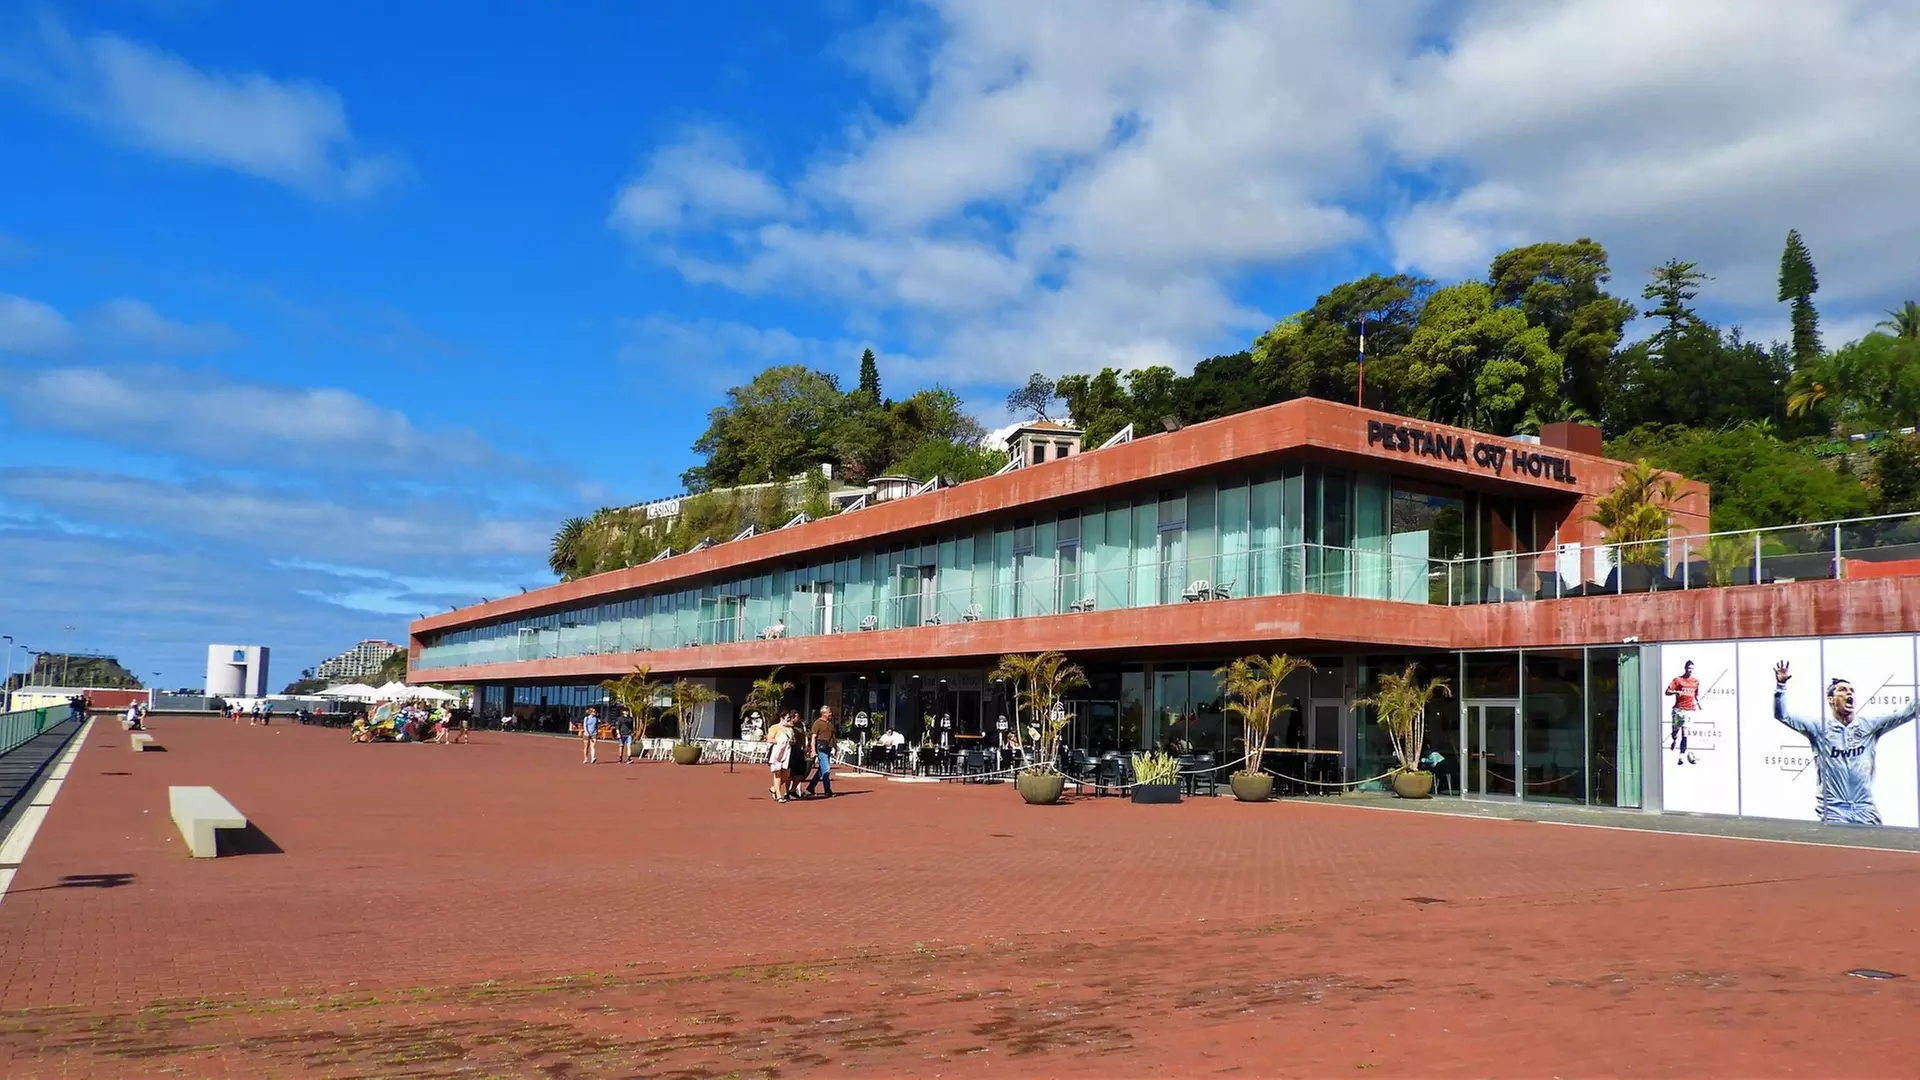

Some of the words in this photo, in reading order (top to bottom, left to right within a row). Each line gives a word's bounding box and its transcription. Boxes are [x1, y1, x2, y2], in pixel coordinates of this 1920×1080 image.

[1367, 420, 1468, 464] PESTANA
[1473, 442, 1507, 476] CR7
[1512, 449, 1577, 484] HOTEL
[648, 502, 677, 517] CASINO
[1830, 745, 1865, 759] bwin
